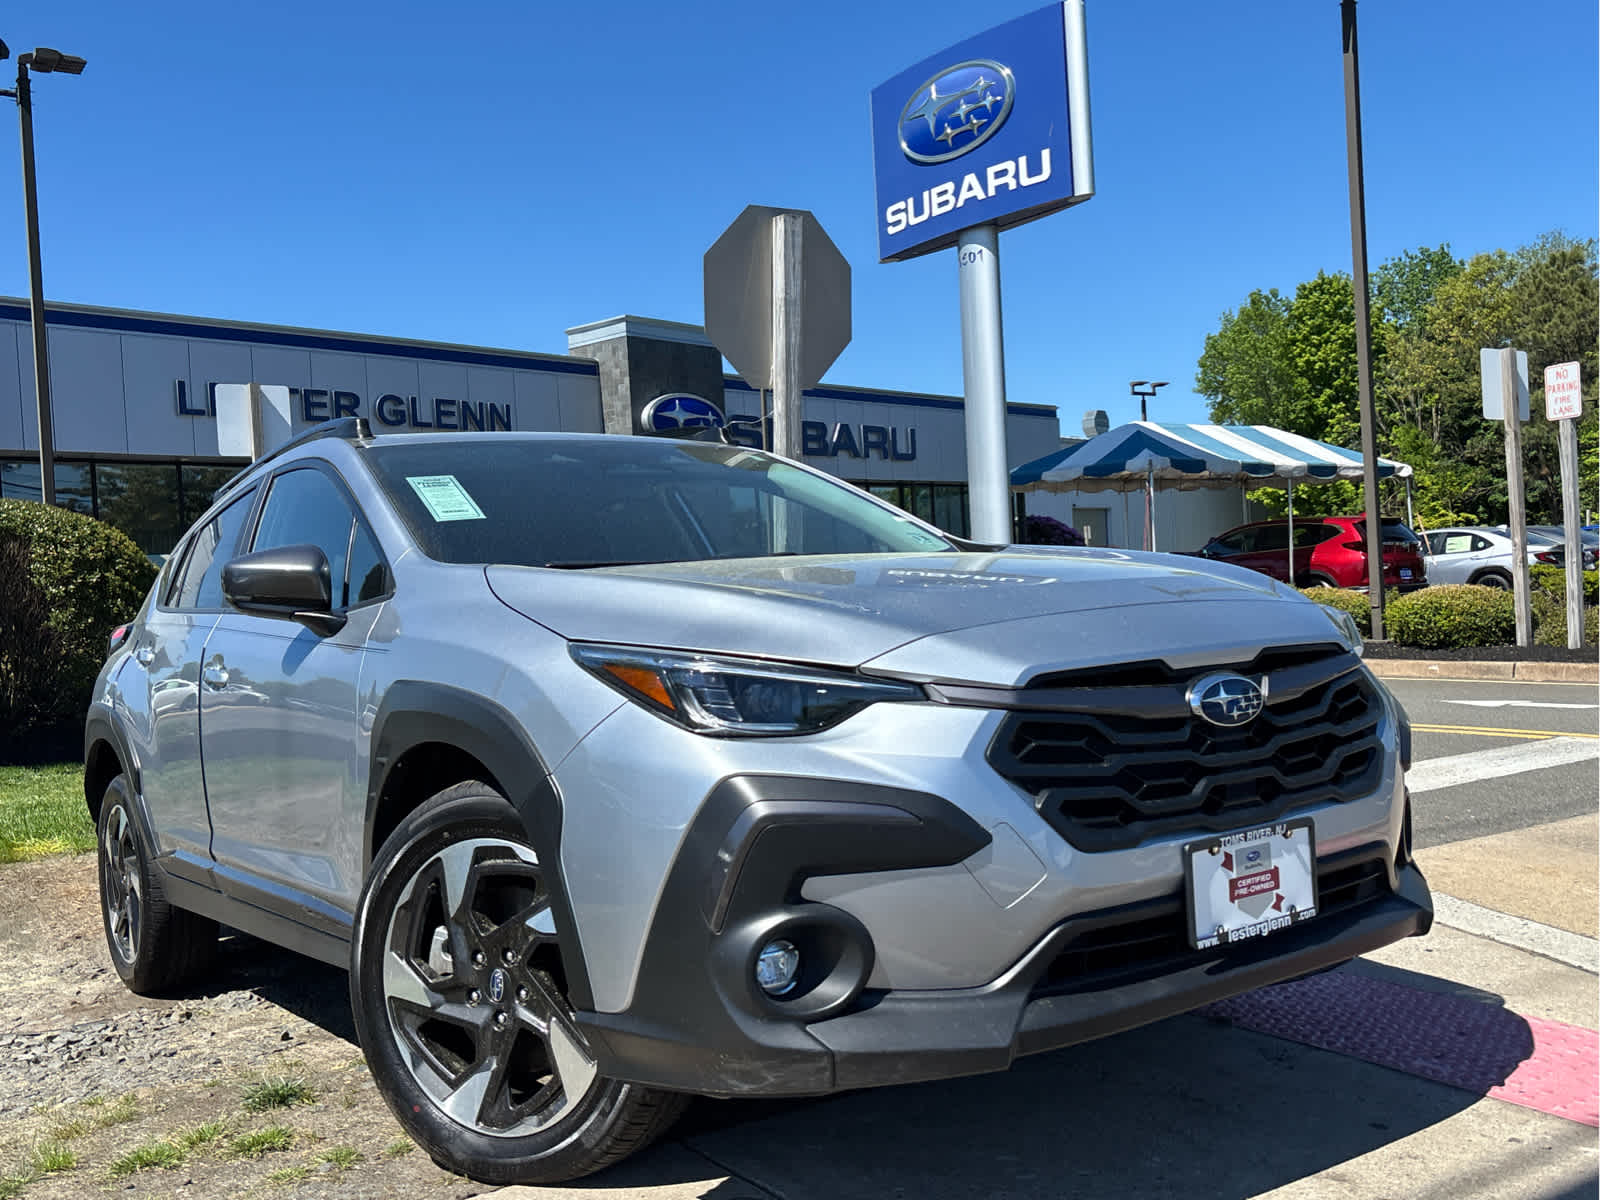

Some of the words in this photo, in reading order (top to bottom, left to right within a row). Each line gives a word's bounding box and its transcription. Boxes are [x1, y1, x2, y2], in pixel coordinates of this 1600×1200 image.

[885, 147, 1052, 236] SUBARU
[1556, 369, 1568, 379] NO
[176, 378, 361, 421] LER
[375, 393, 512, 432] GLENN
[728, 414, 916, 461] SBARU
[1219, 833, 1246, 849] TOMS
[1234, 880, 1275, 897] PRE-OWNED
[1237, 873, 1272, 888] CERTIFIED
[1228, 916, 1291, 942] lesterglenn
